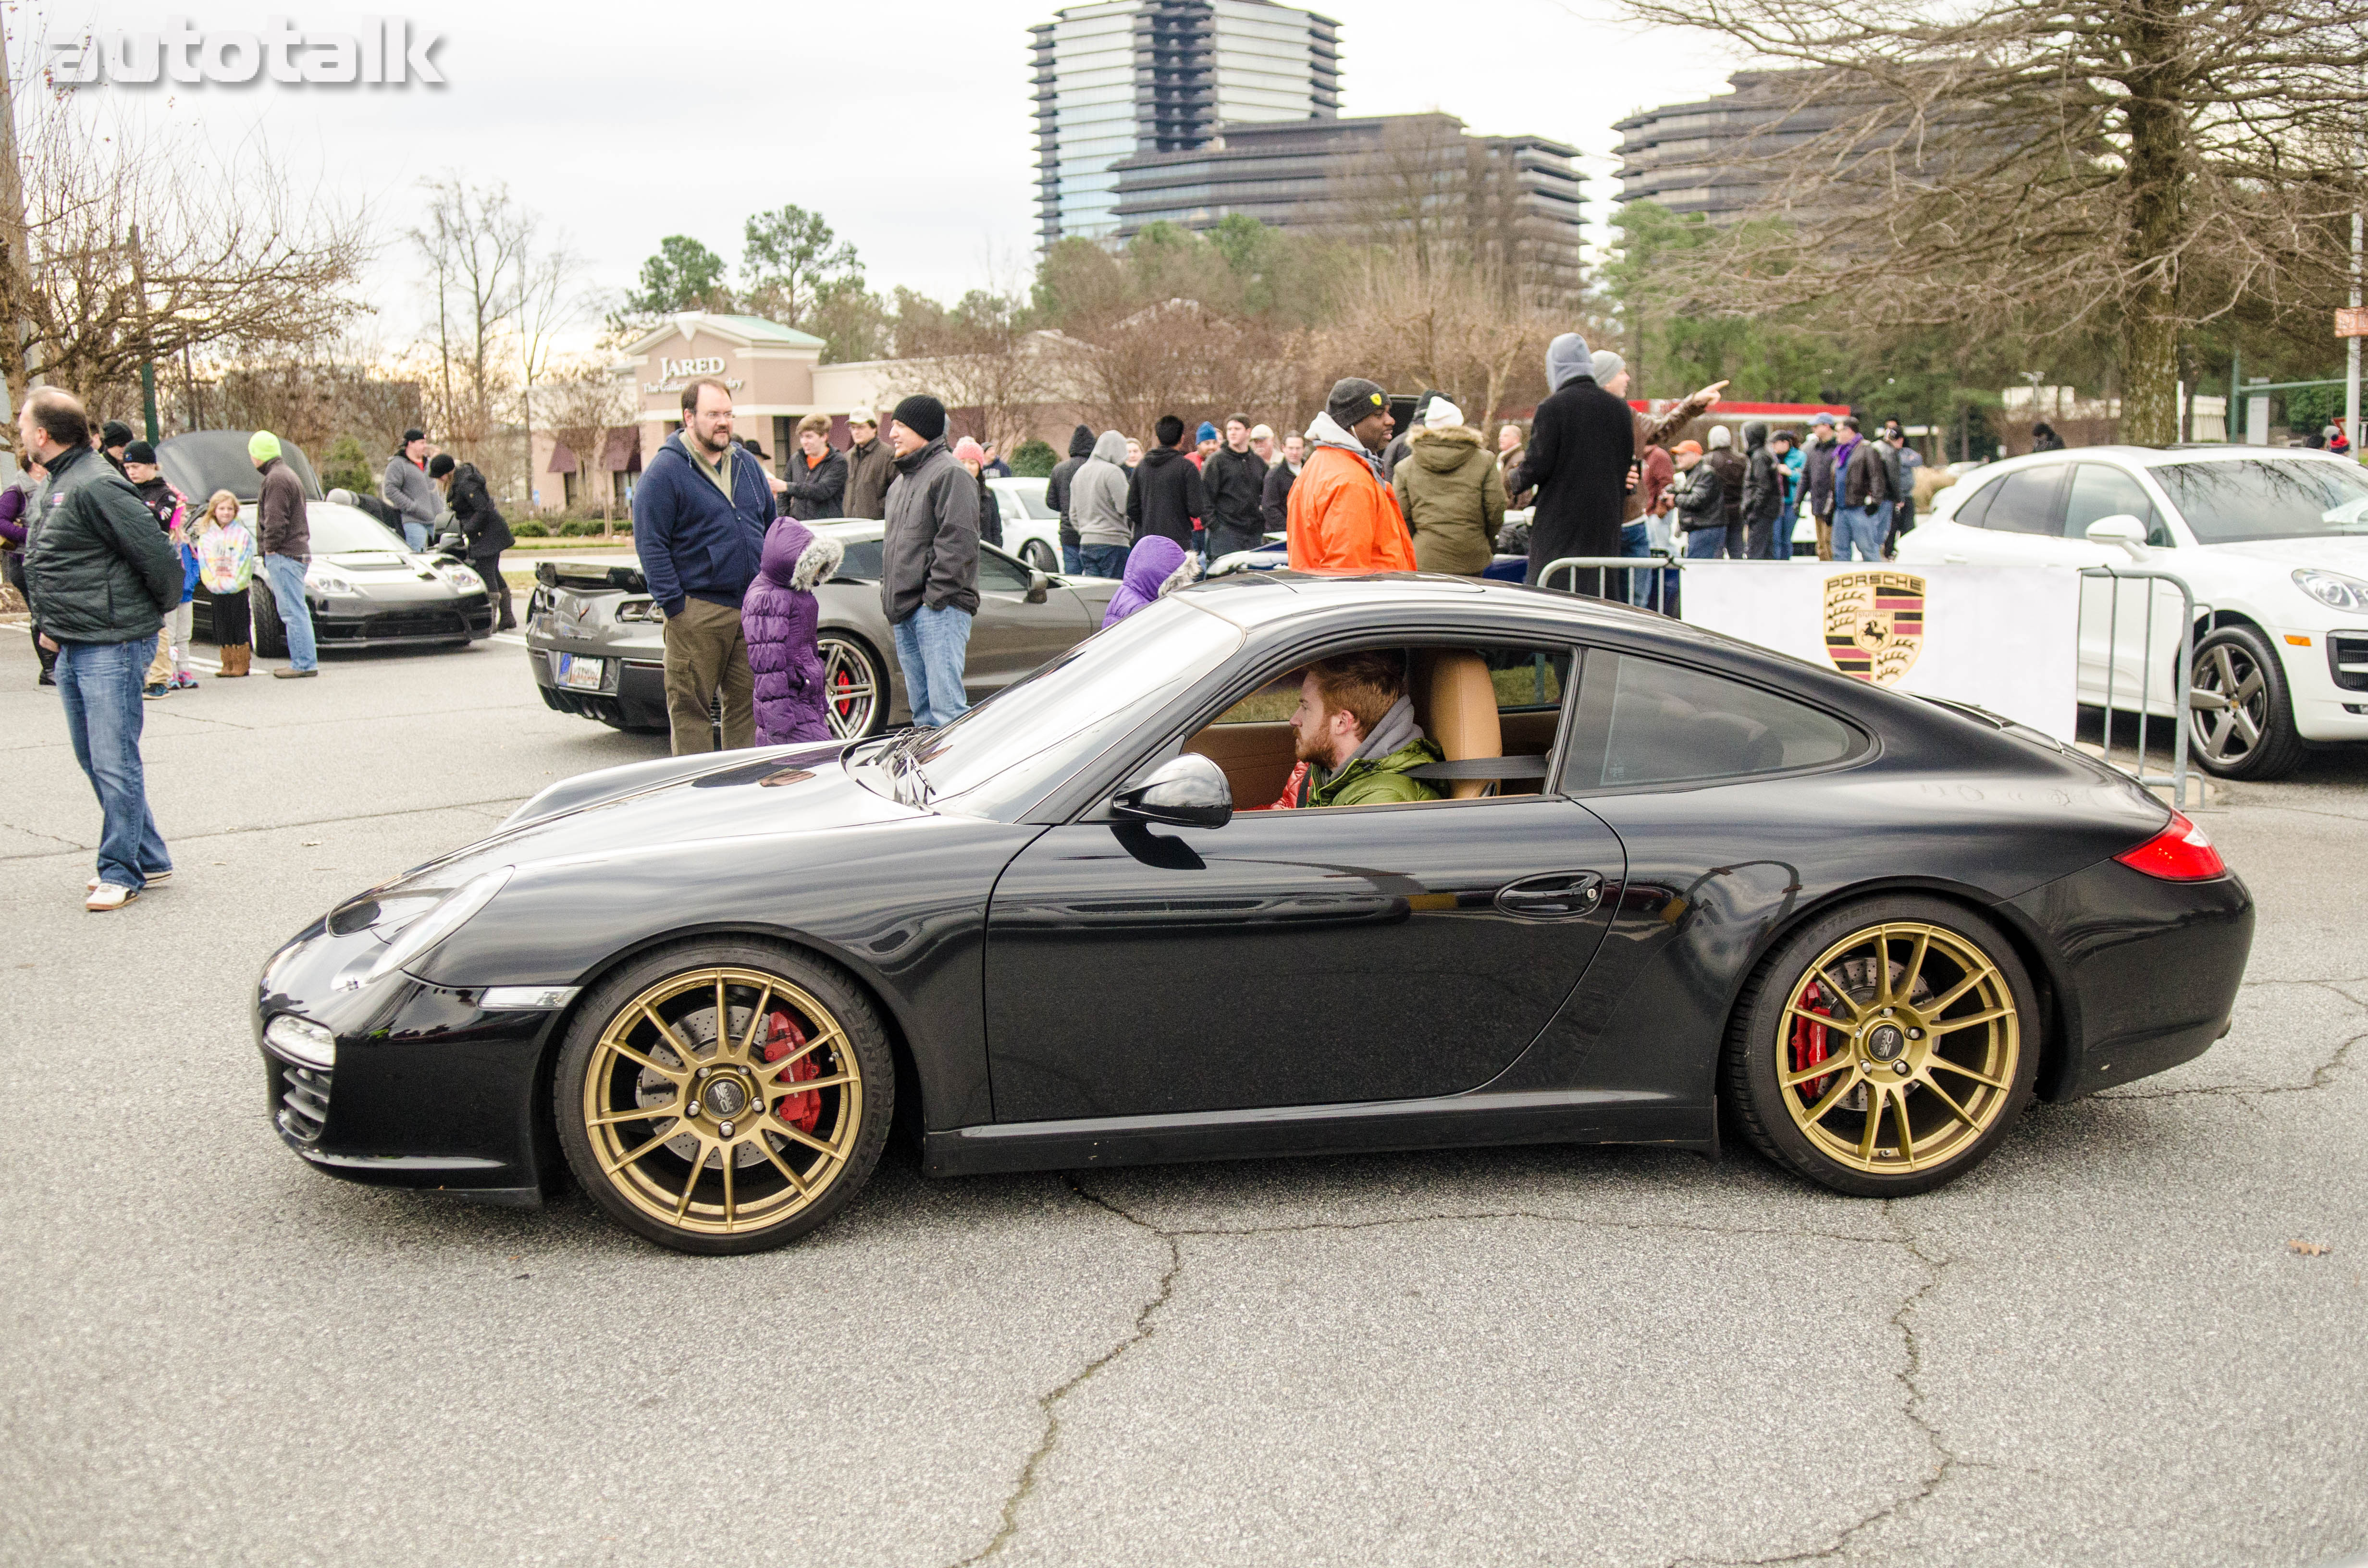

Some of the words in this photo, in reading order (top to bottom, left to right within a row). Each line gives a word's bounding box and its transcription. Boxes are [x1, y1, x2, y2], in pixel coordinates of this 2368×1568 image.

[660, 357, 725, 383] JARED
[643, 383, 659, 393] The
[1827, 574, 1923, 592] PORSCHE
